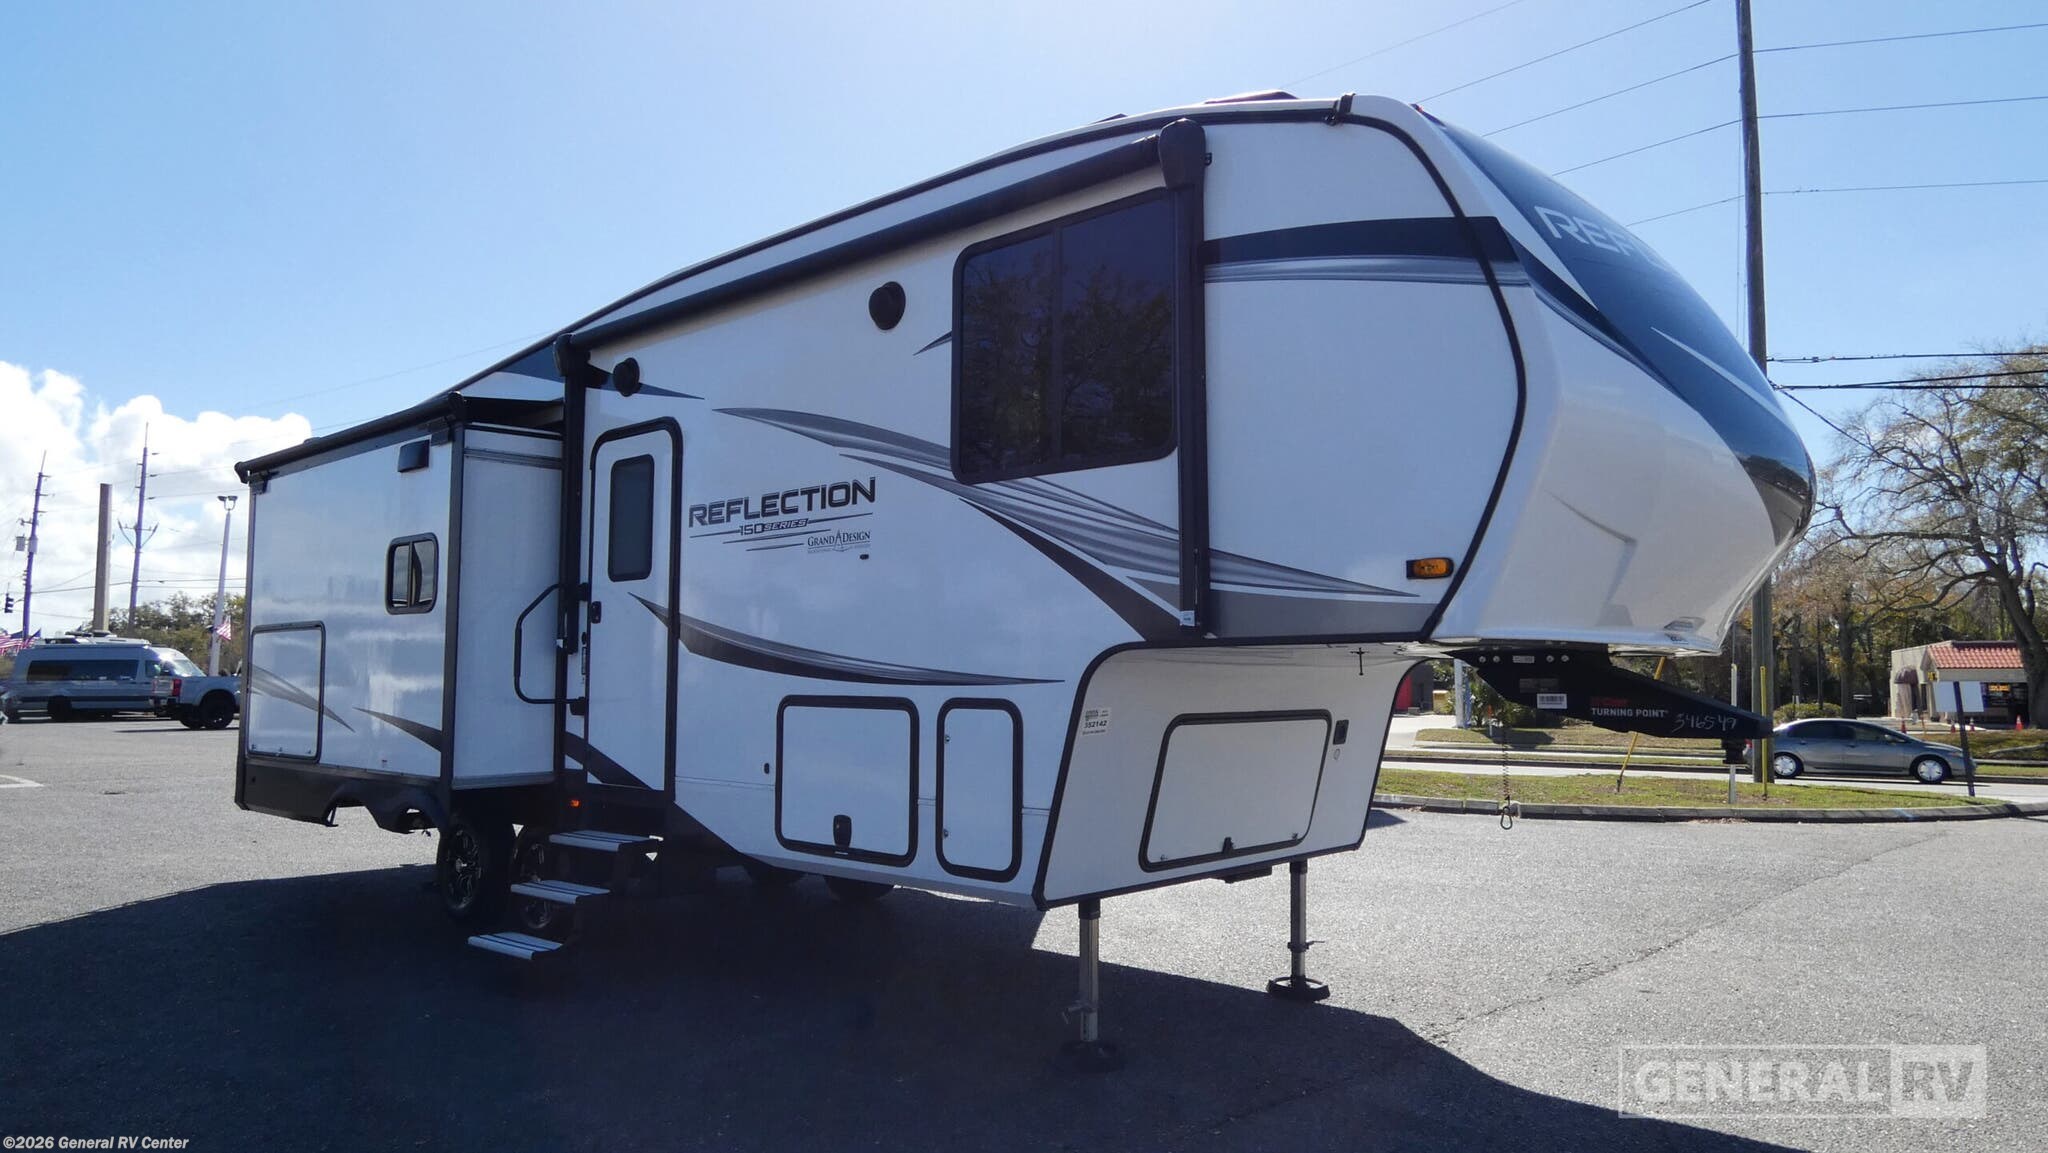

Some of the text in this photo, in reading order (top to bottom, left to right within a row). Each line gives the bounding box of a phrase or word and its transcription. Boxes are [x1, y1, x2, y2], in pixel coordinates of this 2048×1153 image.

[688, 476, 876, 528] REFLECTION
[764, 519, 808, 532] SERIES
[1591, 707, 1633, 717] TURNING
